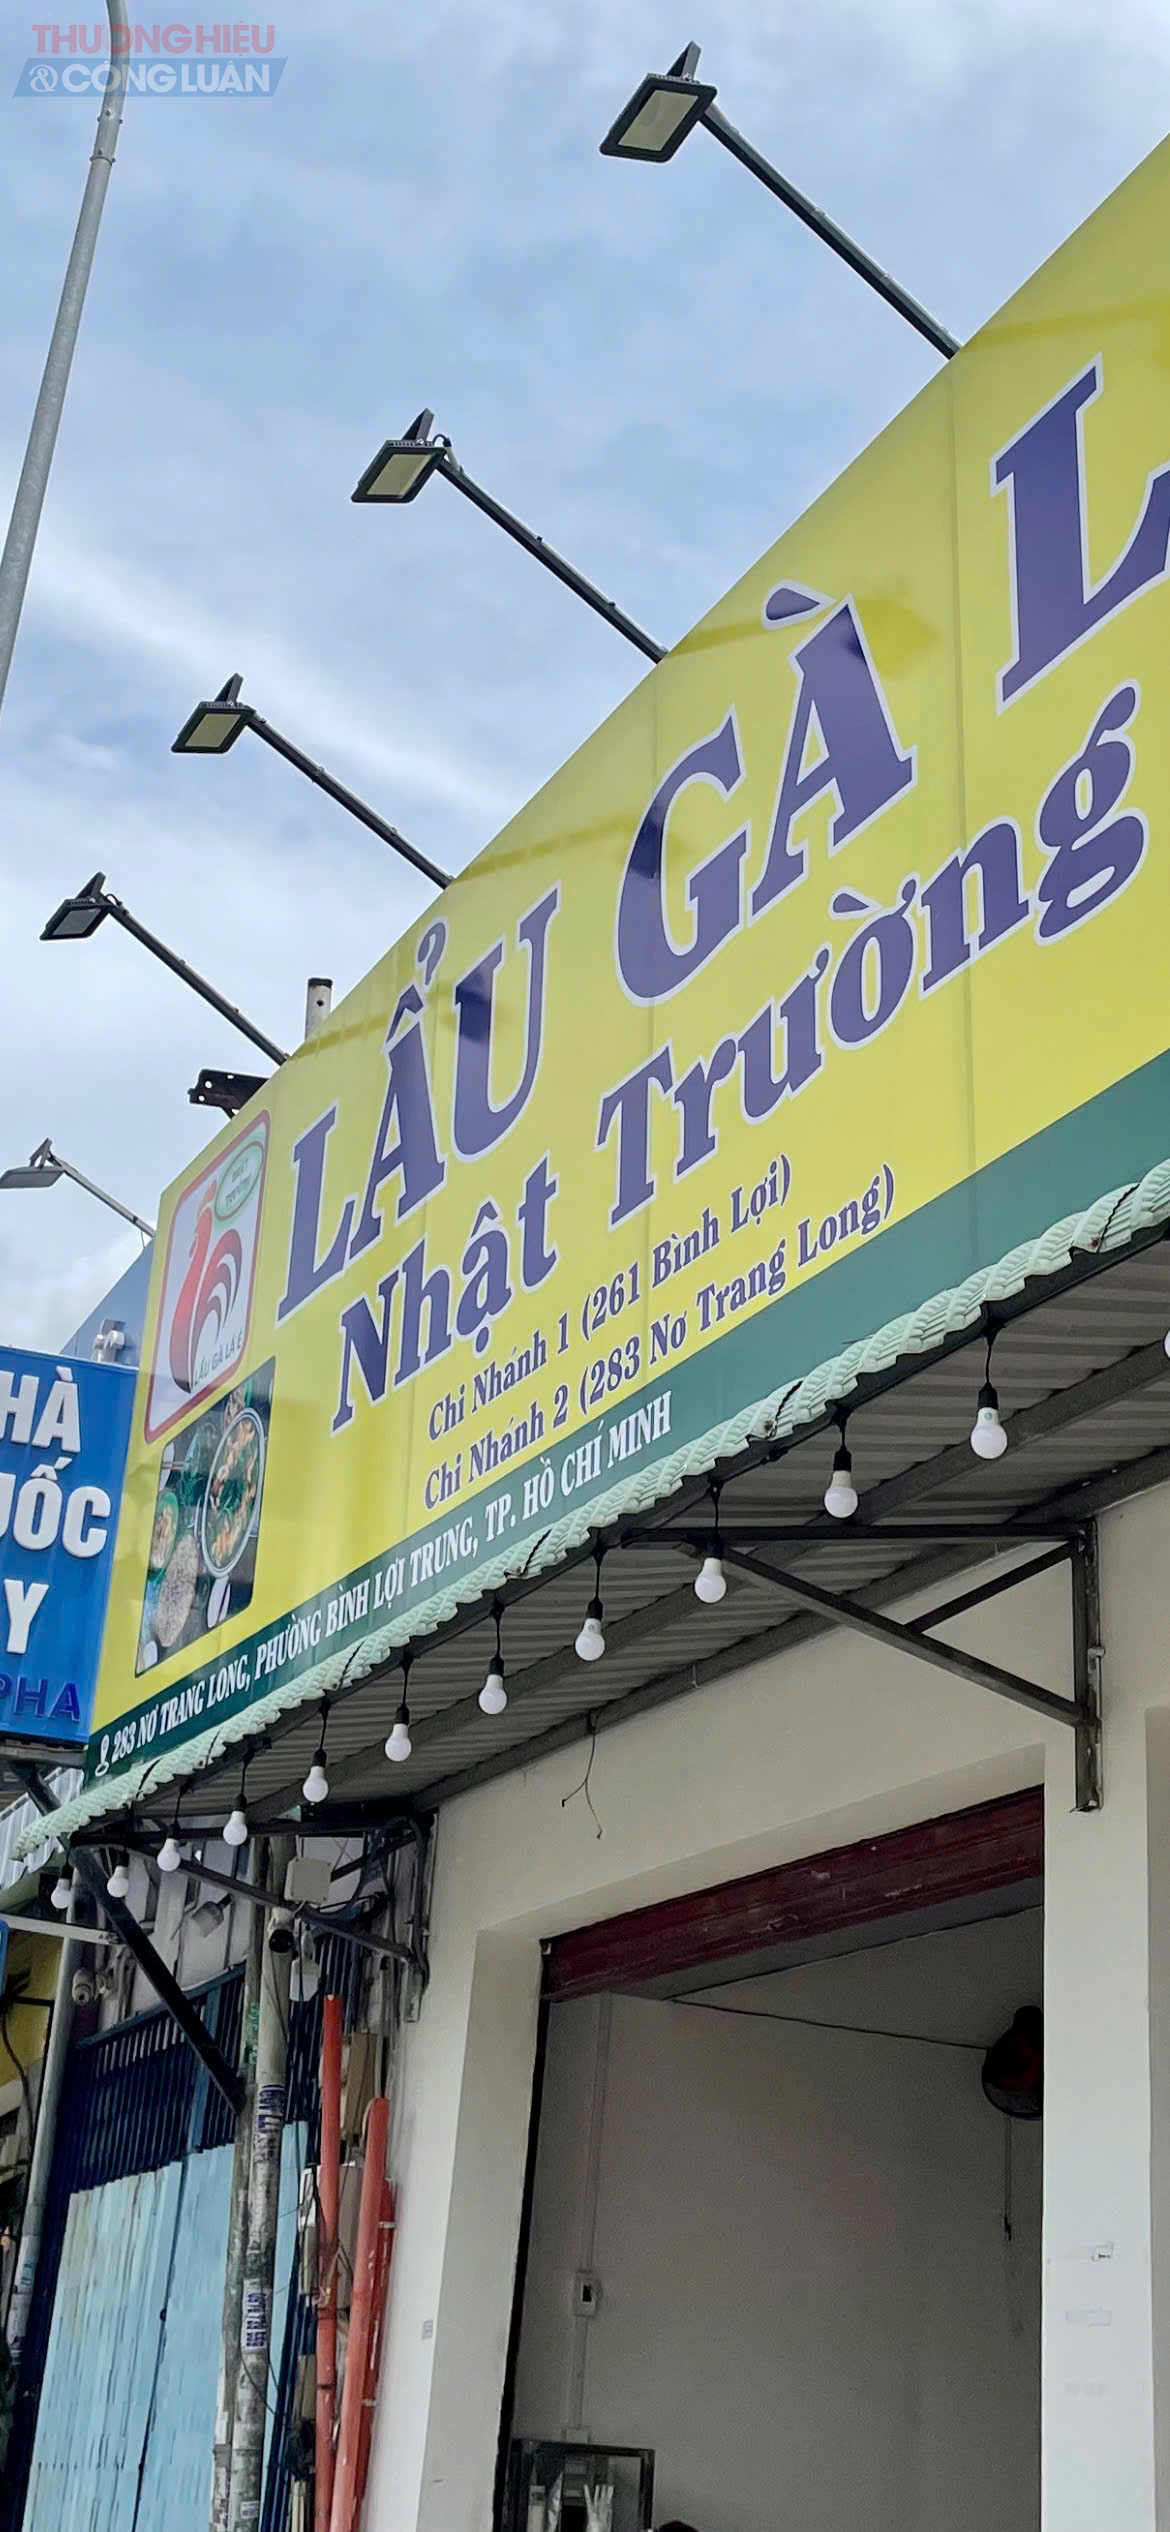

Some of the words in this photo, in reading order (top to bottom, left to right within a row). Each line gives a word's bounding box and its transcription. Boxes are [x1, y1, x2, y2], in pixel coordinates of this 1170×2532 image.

[277, 884, 560, 1325] LẨU
[617, 580, 916, 1006] GÀ
[332, 1155, 558, 1432] Nhật
[597, 683, 1144, 1228] Trường
[0, 1365, 81, 1453] HÀ
[424, 1454, 462, 1510] Chi
[468, 1401, 544, 1483] Nhánh
[553, 1384, 569, 1429] 2
[579, 1336, 641, 1415] (283
[650, 1309, 686, 1365] Nơ
[697, 1239, 786, 1331] Trang
[797, 1164, 894, 1267] Long)
[429, 1384, 465, 1441] Chi
[472, 1330, 547, 1413] Nhánh
[557, 1312, 569, 1354] 1
[581, 1262, 641, 1341] (261
[652, 1208, 720, 1288] Bình
[730, 1154, 790, 1226] Lợi)
[4, 1578, 49, 1653] Y
[112, 1721, 135, 1763] 283
[136, 1704, 159, 1748] NƠ
[160, 1680, 204, 1736] TRANG
[206, 1654, 250, 1708] LONG,
[255, 1610, 321, 1680] PHƯỜNG
[325, 1579, 370, 1637] BÌNH
[373, 1557, 406, 1609] LỢI
[410, 1516, 479, 1587] TRUNG,
[485, 1493, 516, 1543] TP.
[522, 1456, 555, 1520] HỒ
[560, 1419, 604, 1496] CHÍ
[607, 1390, 672, 1468] MINH
